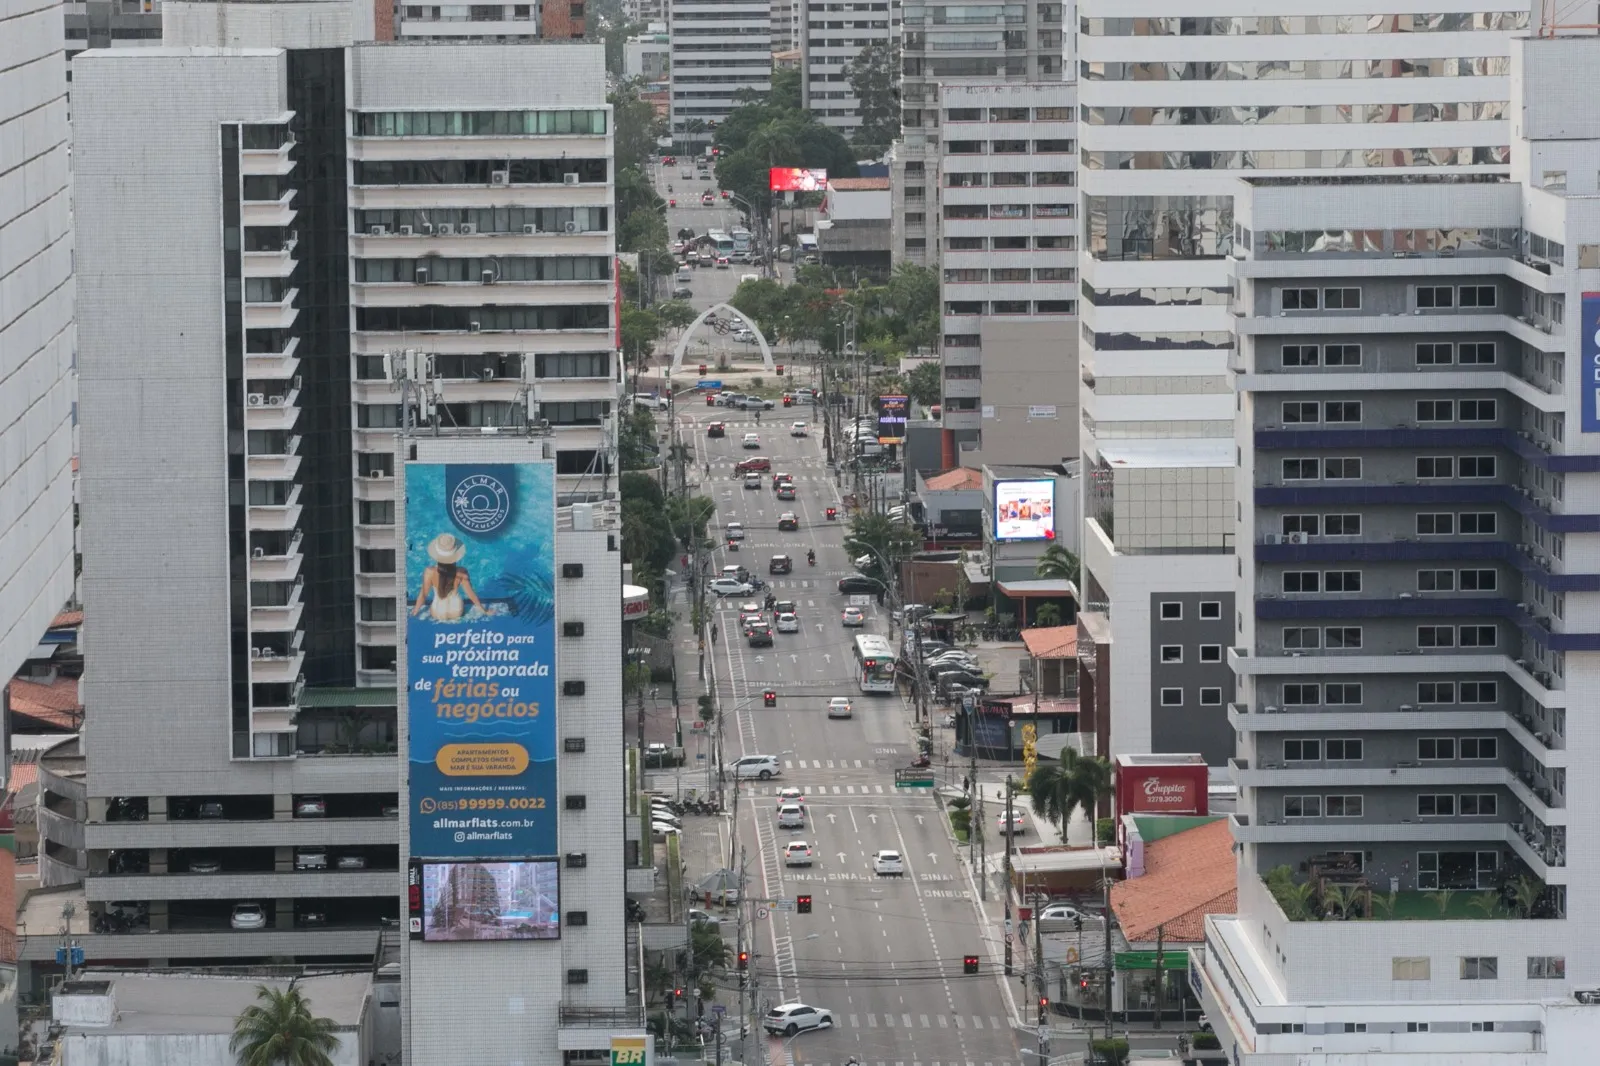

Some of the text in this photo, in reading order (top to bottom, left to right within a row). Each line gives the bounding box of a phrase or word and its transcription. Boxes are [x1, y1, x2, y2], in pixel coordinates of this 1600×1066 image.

[458, 477, 504, 495] ALLMAR
[456, 510, 505, 529] APARTAMENTOS
[434, 629, 535, 648] perfeito para
[422, 646, 520, 666] sua próxima
[452, 661, 549, 681] temporada
[414, 678, 520, 703] de férias ou
[436, 699, 540, 723] negócios
[459, 798, 546, 810] 99999.0022
[433, 818, 534, 829] allmarflats.com.br
[466, 832, 513, 840] allmarflats
[616, 1047, 643, 1064] BR
